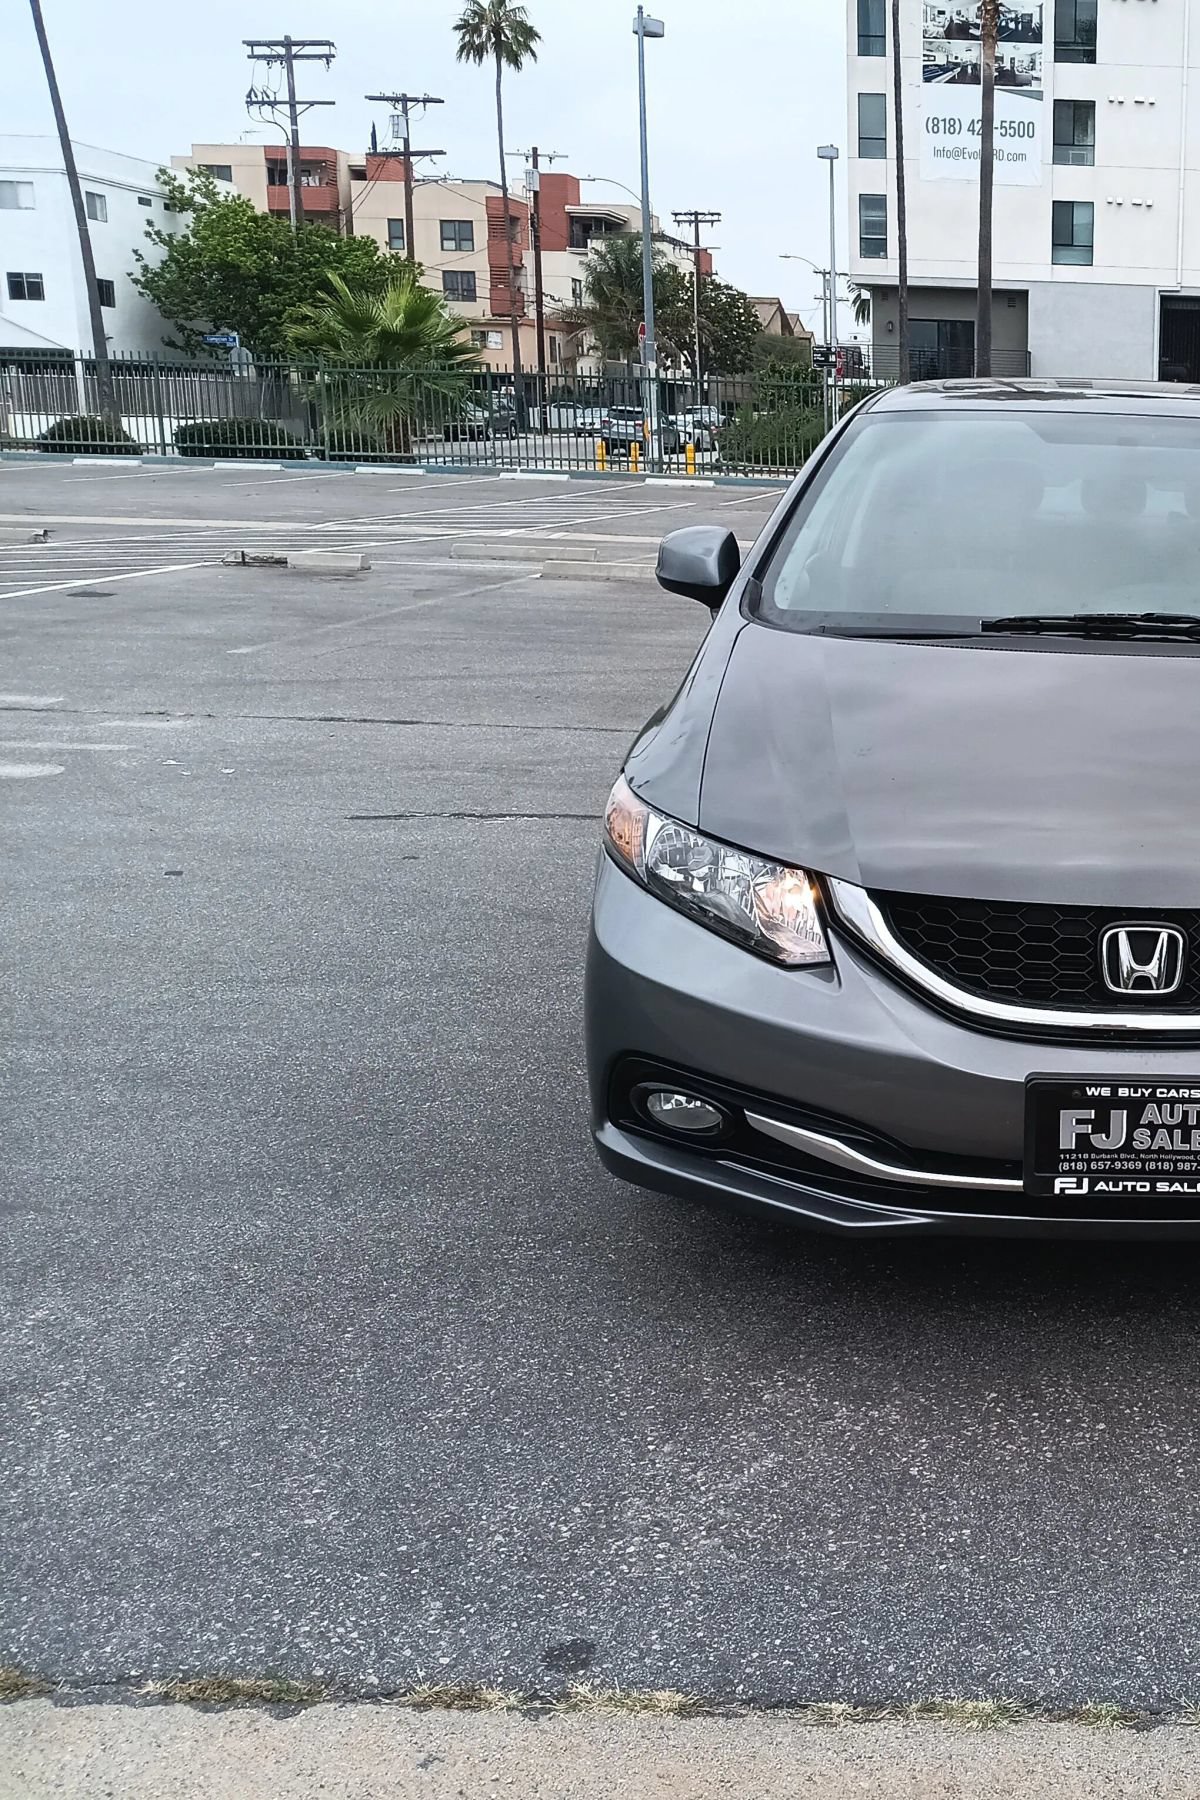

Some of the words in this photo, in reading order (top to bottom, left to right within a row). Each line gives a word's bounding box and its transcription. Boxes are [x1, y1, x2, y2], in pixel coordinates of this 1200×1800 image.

[925, 116, 962, 135] (818)
[967, 118, 1035, 138] 42-5500
[1086, 1086, 1111, 1096] WE
[1118, 1087, 1152, 1098] BUY
[1156, 1088, 1200, 1099] CARS
[1059, 1109, 1127, 1150] FJ
[1058, 1161, 1087, 1172] (818)
[1090, 1161, 1142, 1170] 657-9369
[1145, 1161, 1174, 1172] (818)
[1054, 1177, 1089, 1195] FJ
[1094, 1181, 1151, 1192] AUTO
